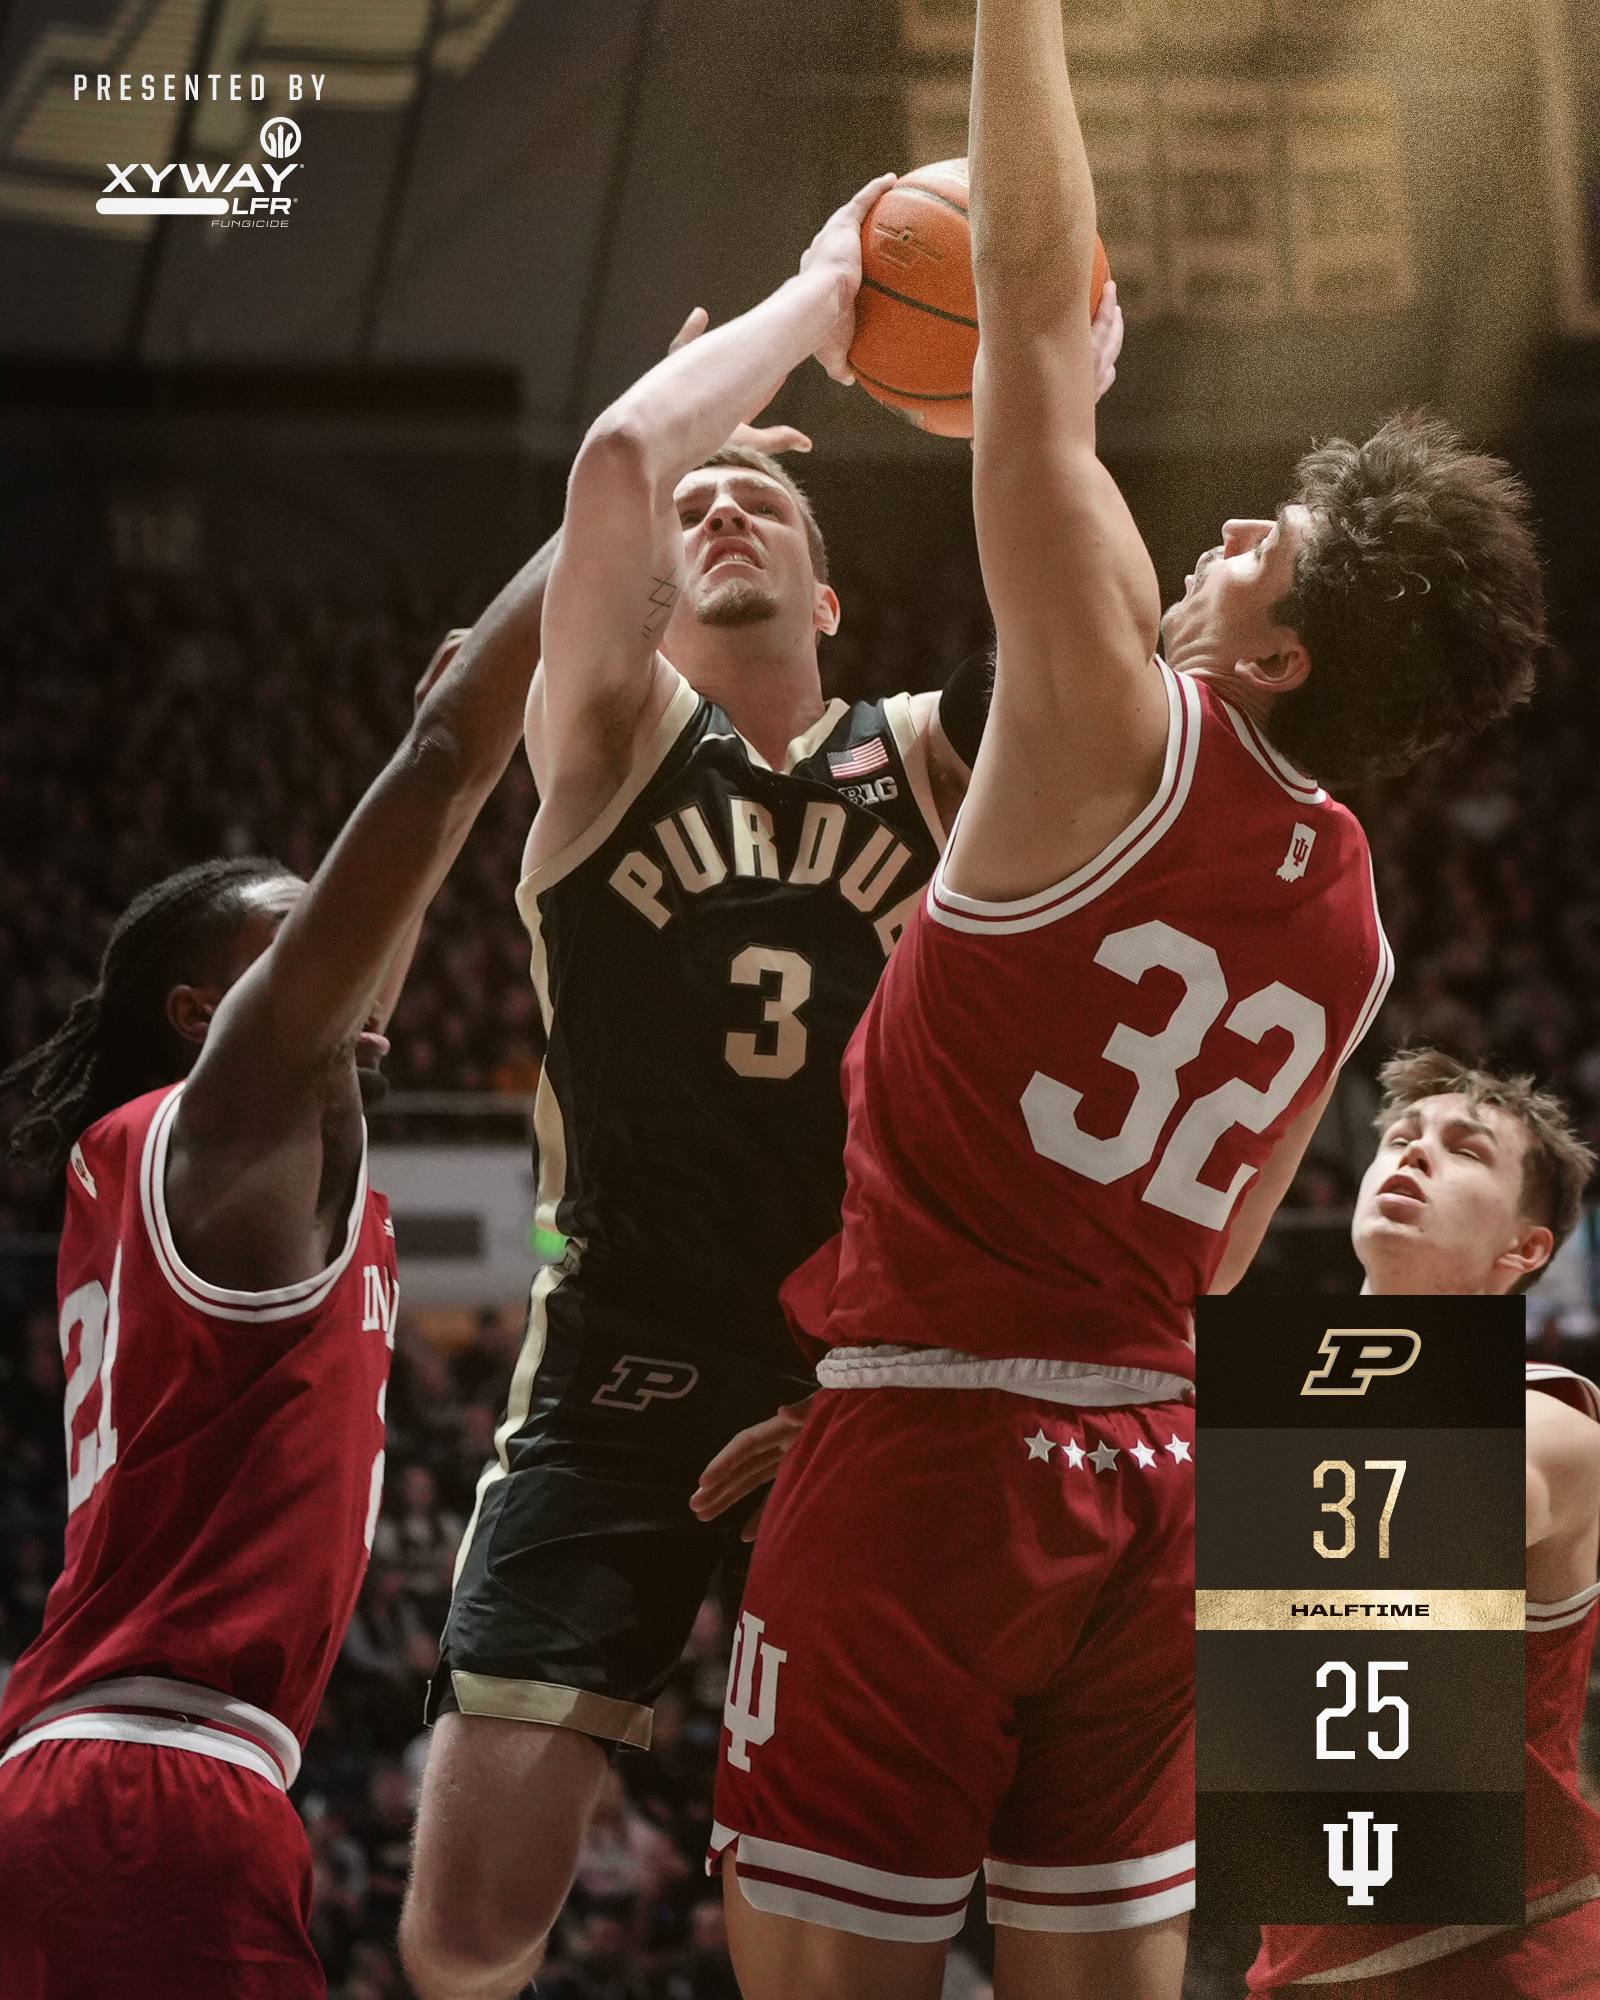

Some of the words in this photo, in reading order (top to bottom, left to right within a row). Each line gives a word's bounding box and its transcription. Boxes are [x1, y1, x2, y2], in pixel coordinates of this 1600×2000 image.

[724, 945, 813, 1080] 3
[1019, 919, 1327, 1232] 32
[591, 1354, 699, 1412] P
